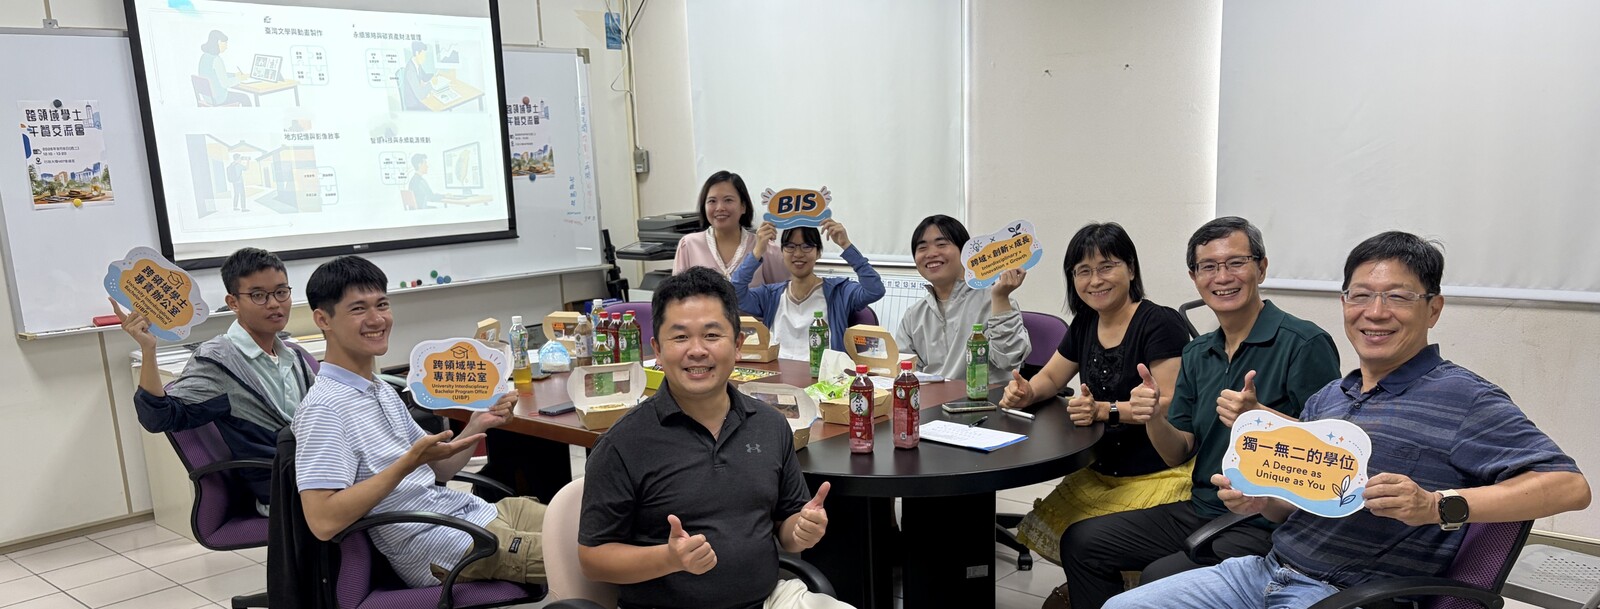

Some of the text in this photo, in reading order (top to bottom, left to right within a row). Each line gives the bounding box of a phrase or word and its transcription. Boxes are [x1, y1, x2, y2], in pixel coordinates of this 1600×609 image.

[264, 26, 323, 37] 臺灣文學與動畫製作
[25, 108, 83, 122] 跨領域學士
[28, 123, 85, 137] 午餐交流會
[284, 132, 341, 141] 地方記憶與影像敘事
[778, 193, 816, 214] BIS
[980, 263, 1005, 276] Innovation
[1009, 253, 1027, 264] Growth
[981, 252, 1018, 270] Interdisciplinary
[134, 273, 181, 318] 專責辦公室
[141, 265, 188, 309] 跨領域學士
[124, 285, 168, 325] Bachelor Program Office
[126, 279, 172, 323] University Interdisciplinary
[433, 359, 487, 371] 跨領域學士
[433, 371, 487, 383] 專責辦公室
[1242, 435, 1355, 471] 獨一無二的學位
[1262, 459, 1322, 479] A Degree as
[1255, 468, 1326, 491] Unique as You
